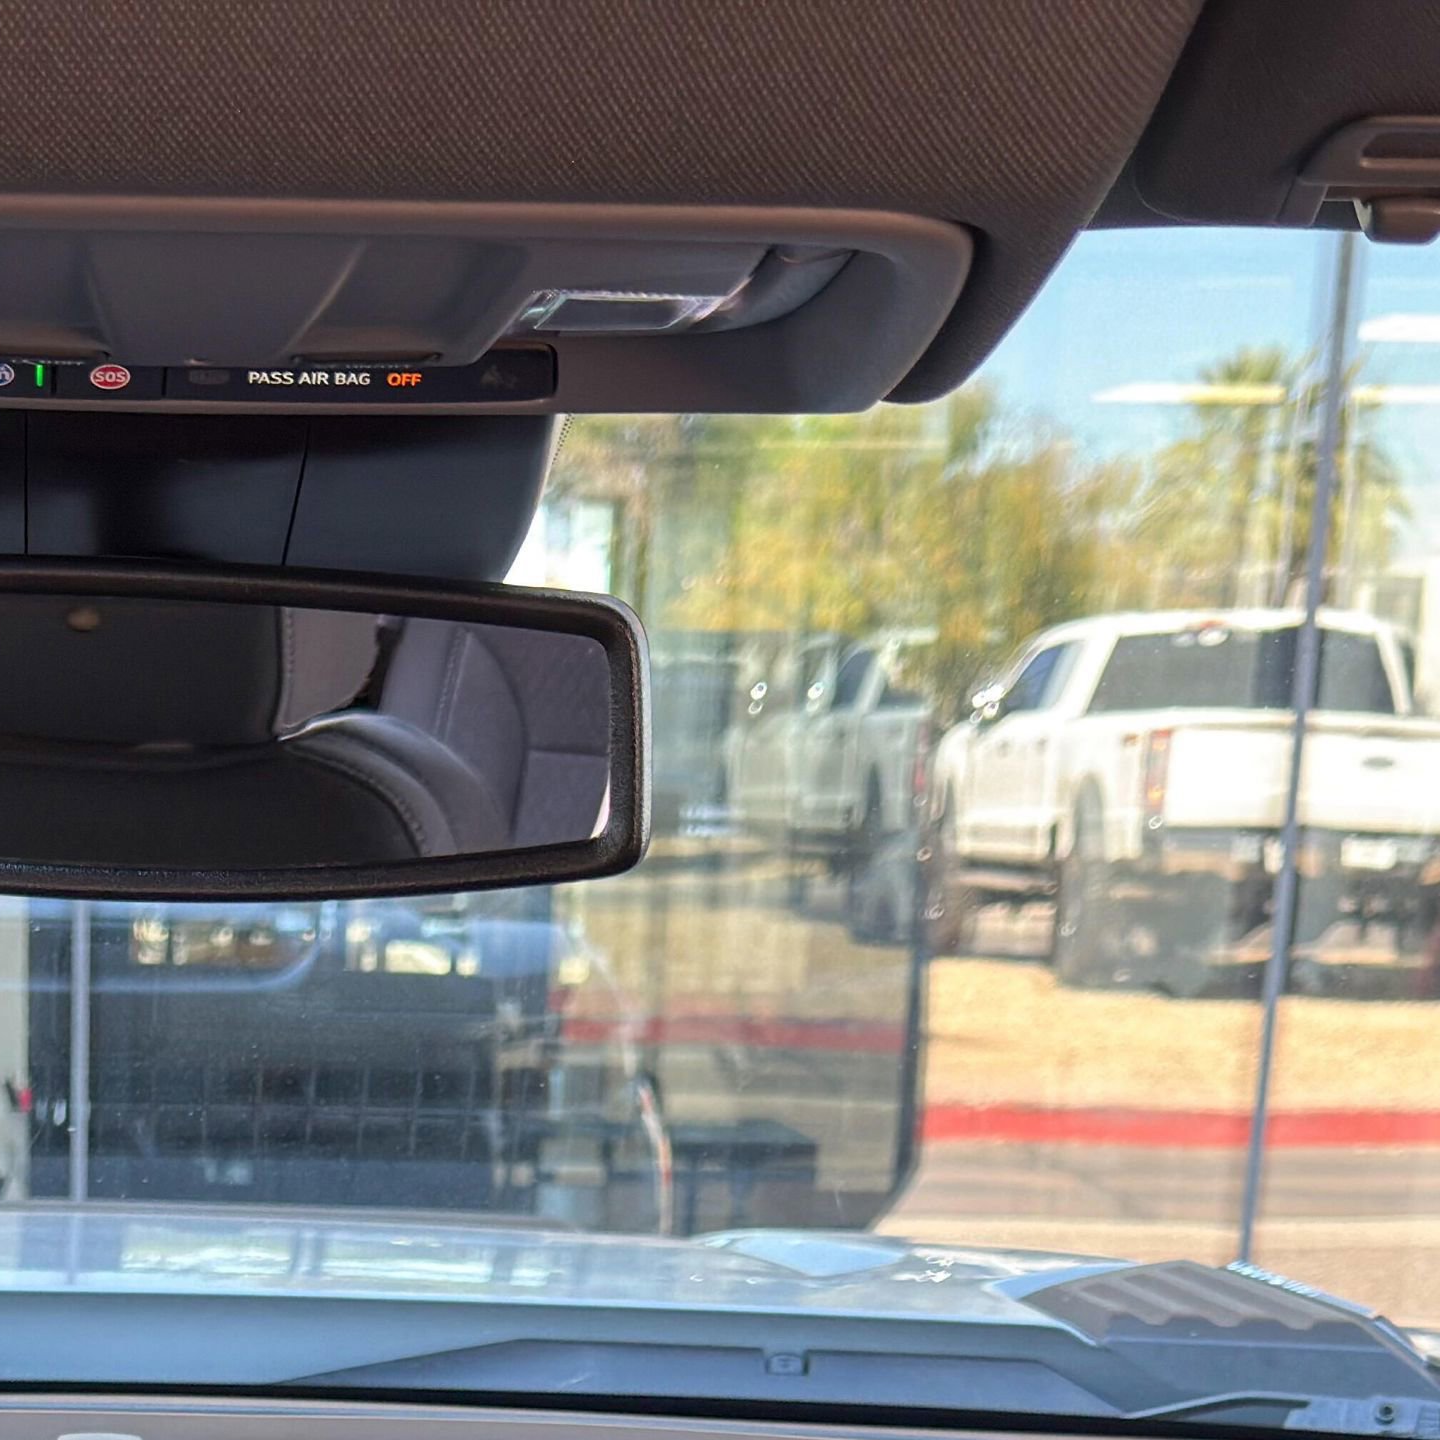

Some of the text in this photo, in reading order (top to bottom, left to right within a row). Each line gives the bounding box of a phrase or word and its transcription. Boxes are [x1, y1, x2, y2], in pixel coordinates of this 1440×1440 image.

[94, 370, 126, 384] SOS
[247, 371, 294, 386] PASS
[298, 371, 330, 386] AIR
[334, 372, 371, 387] BAG
[386, 372, 422, 387] OFF
